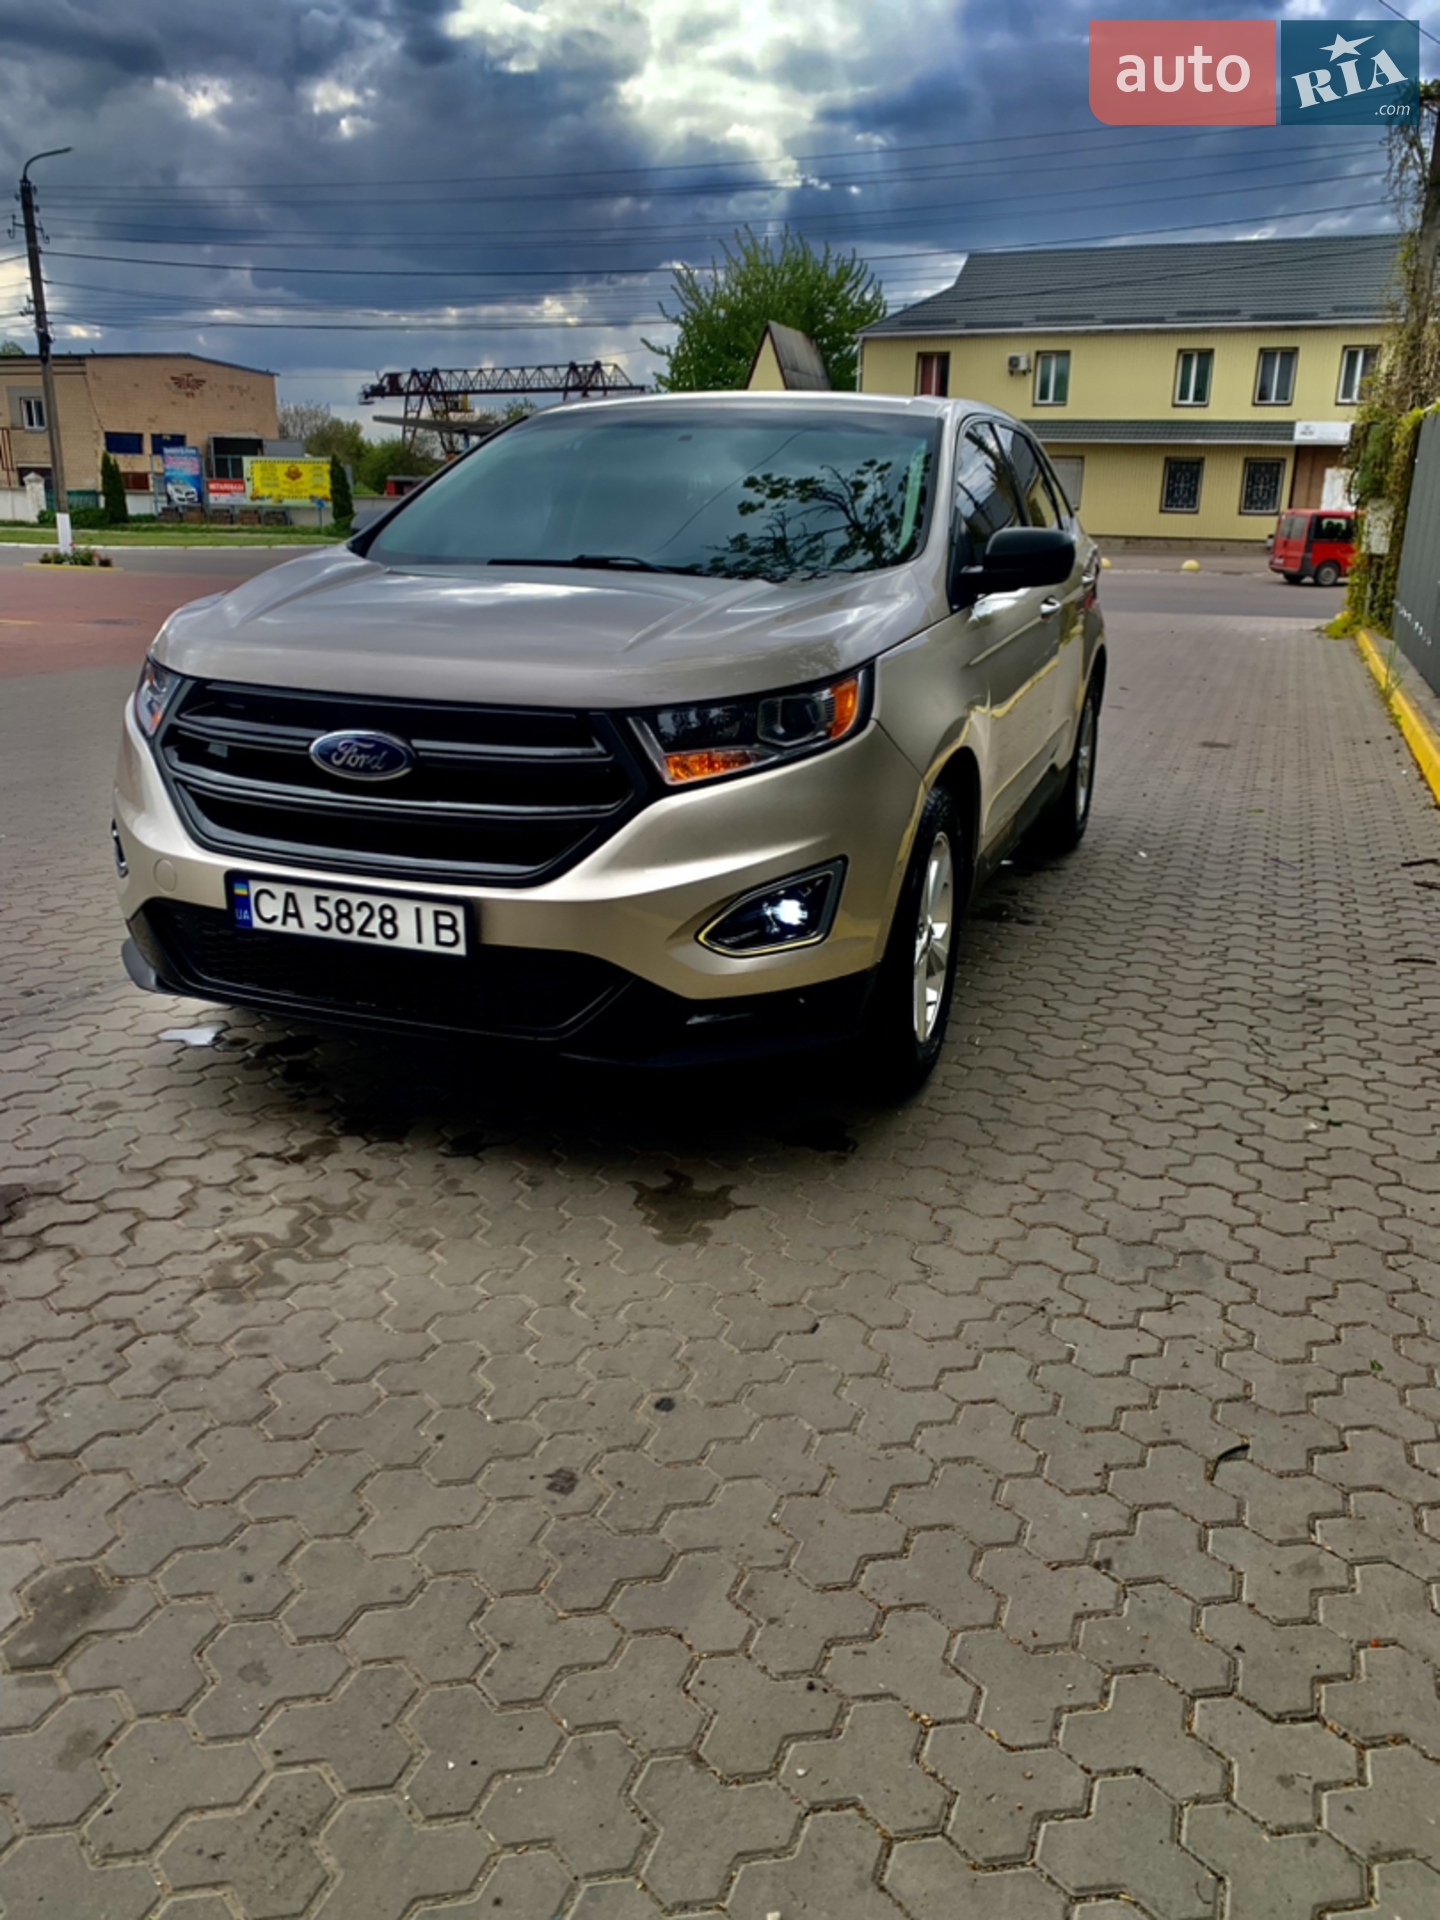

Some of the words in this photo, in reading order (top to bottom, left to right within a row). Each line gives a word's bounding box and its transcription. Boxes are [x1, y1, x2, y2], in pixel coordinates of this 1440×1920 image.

[331, 739, 387, 771] Ford
[235, 908, 250, 920] UA
[253, 887, 304, 929] CA
[314, 894, 399, 940] 5828
[415, 906, 460, 948] IB
